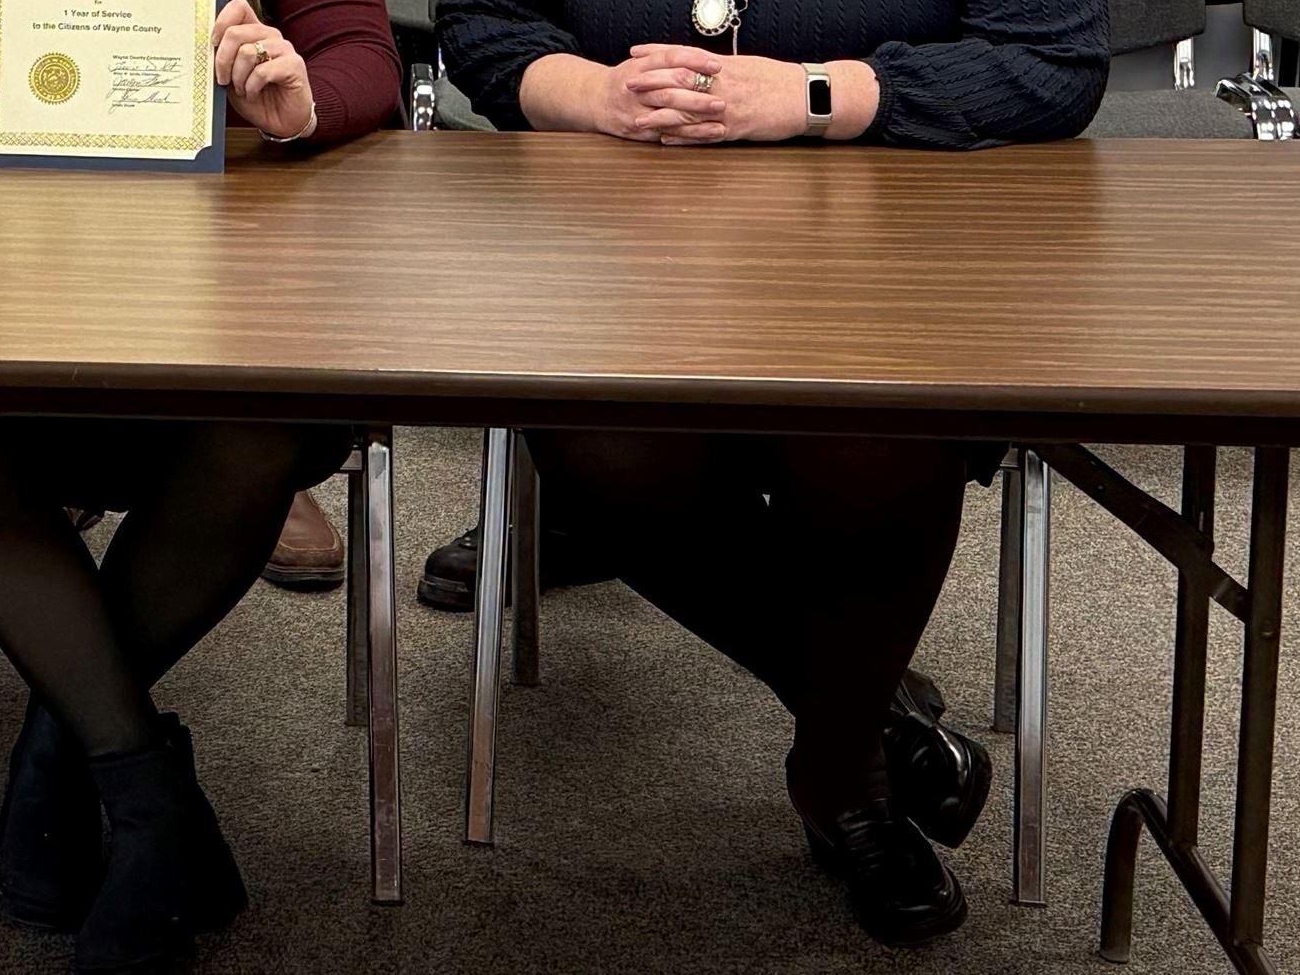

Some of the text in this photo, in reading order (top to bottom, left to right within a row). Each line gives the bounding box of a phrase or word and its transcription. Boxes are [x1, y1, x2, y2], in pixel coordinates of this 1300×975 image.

[102, 10, 132, 18] Service
[43, 22, 56, 30] the
[103, 24, 130, 33] Wayne
[133, 25, 162, 34] County
